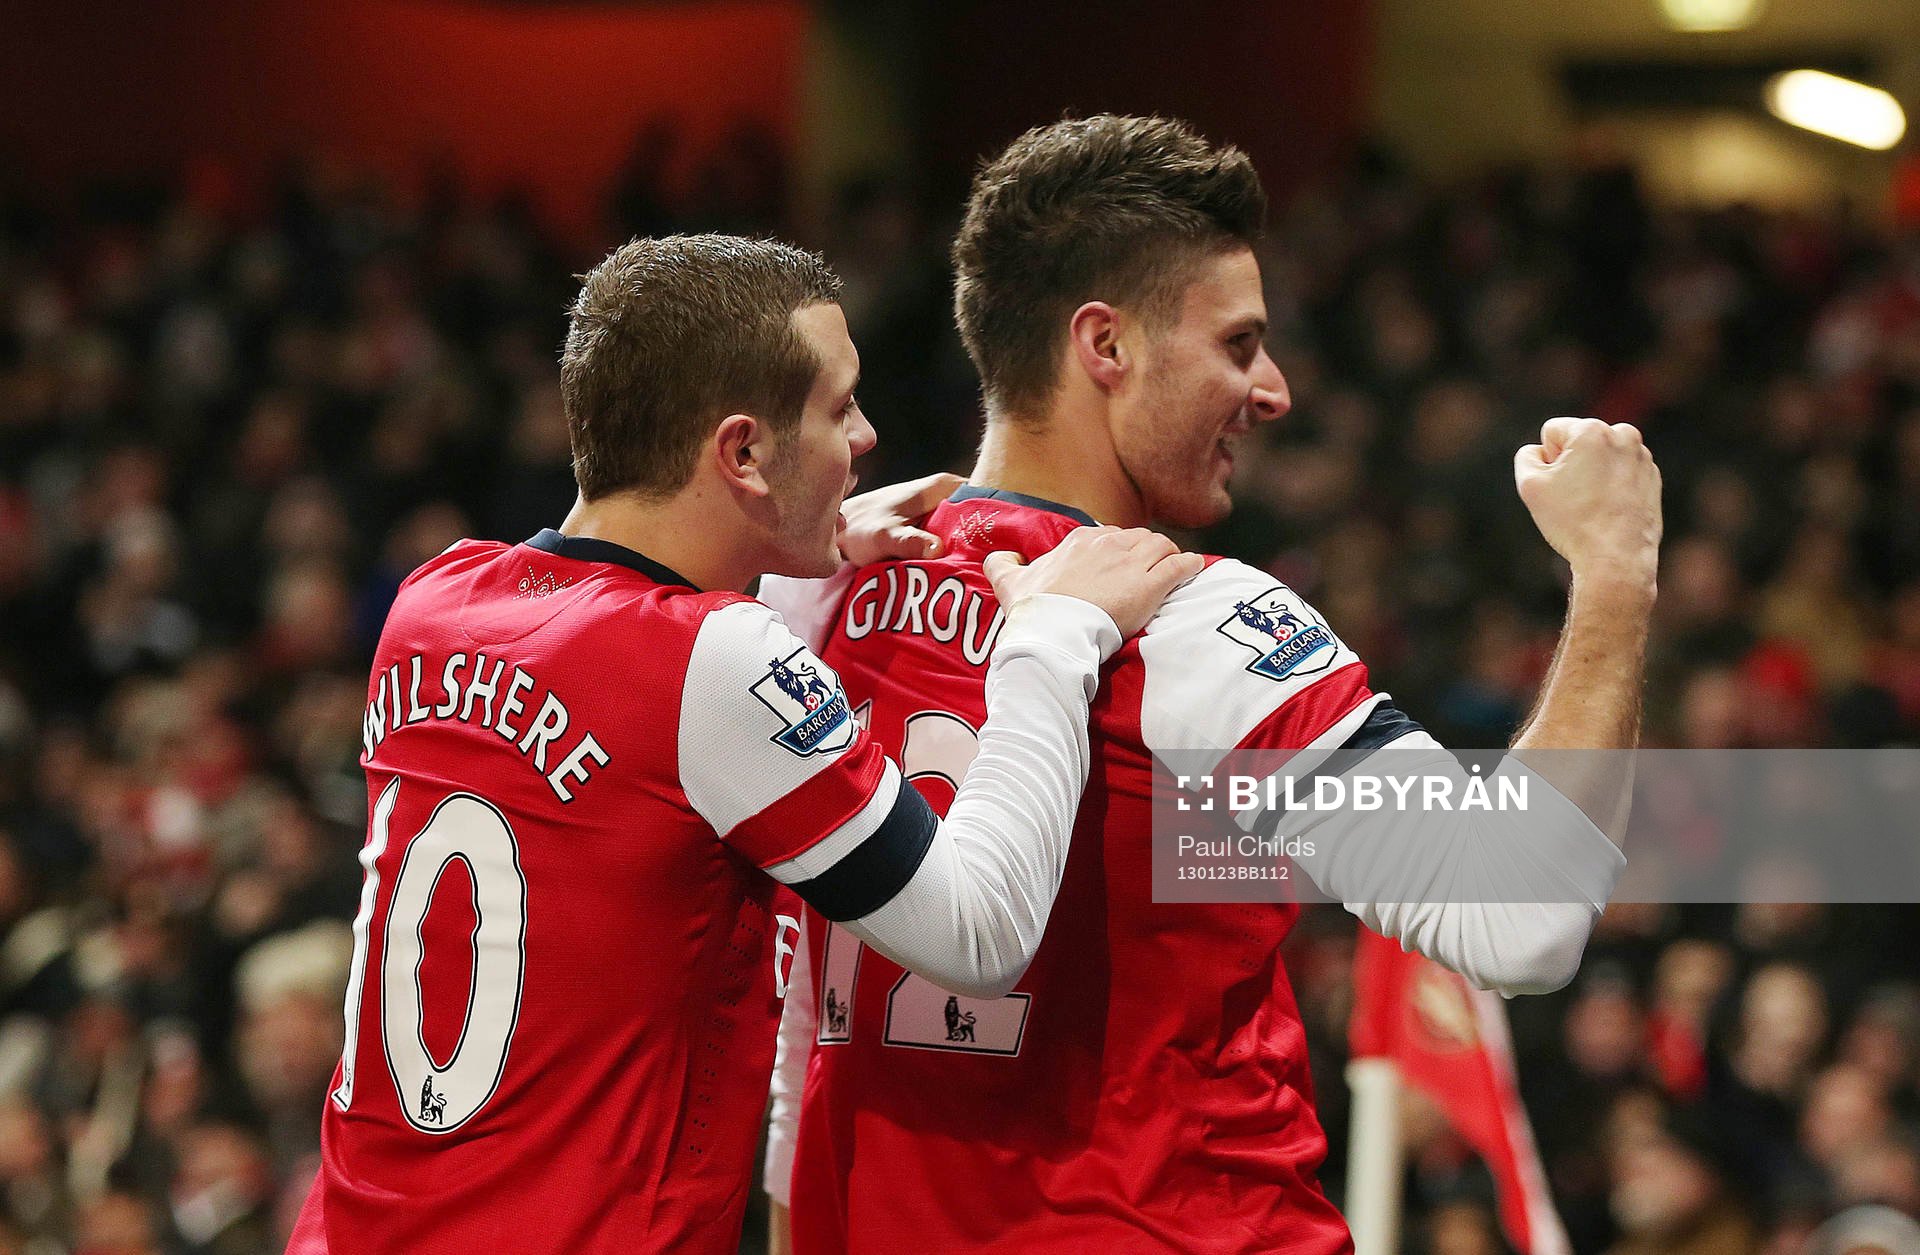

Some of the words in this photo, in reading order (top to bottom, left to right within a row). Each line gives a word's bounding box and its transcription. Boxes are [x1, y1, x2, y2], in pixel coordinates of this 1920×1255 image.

[1269, 628, 1321, 667] BARCLAYS
[1277, 647, 1306, 673] PREMIER
[362, 652, 612, 804] WILSHERE
[796, 697, 843, 741] BARCLAYS
[331, 774, 529, 1135] 10
